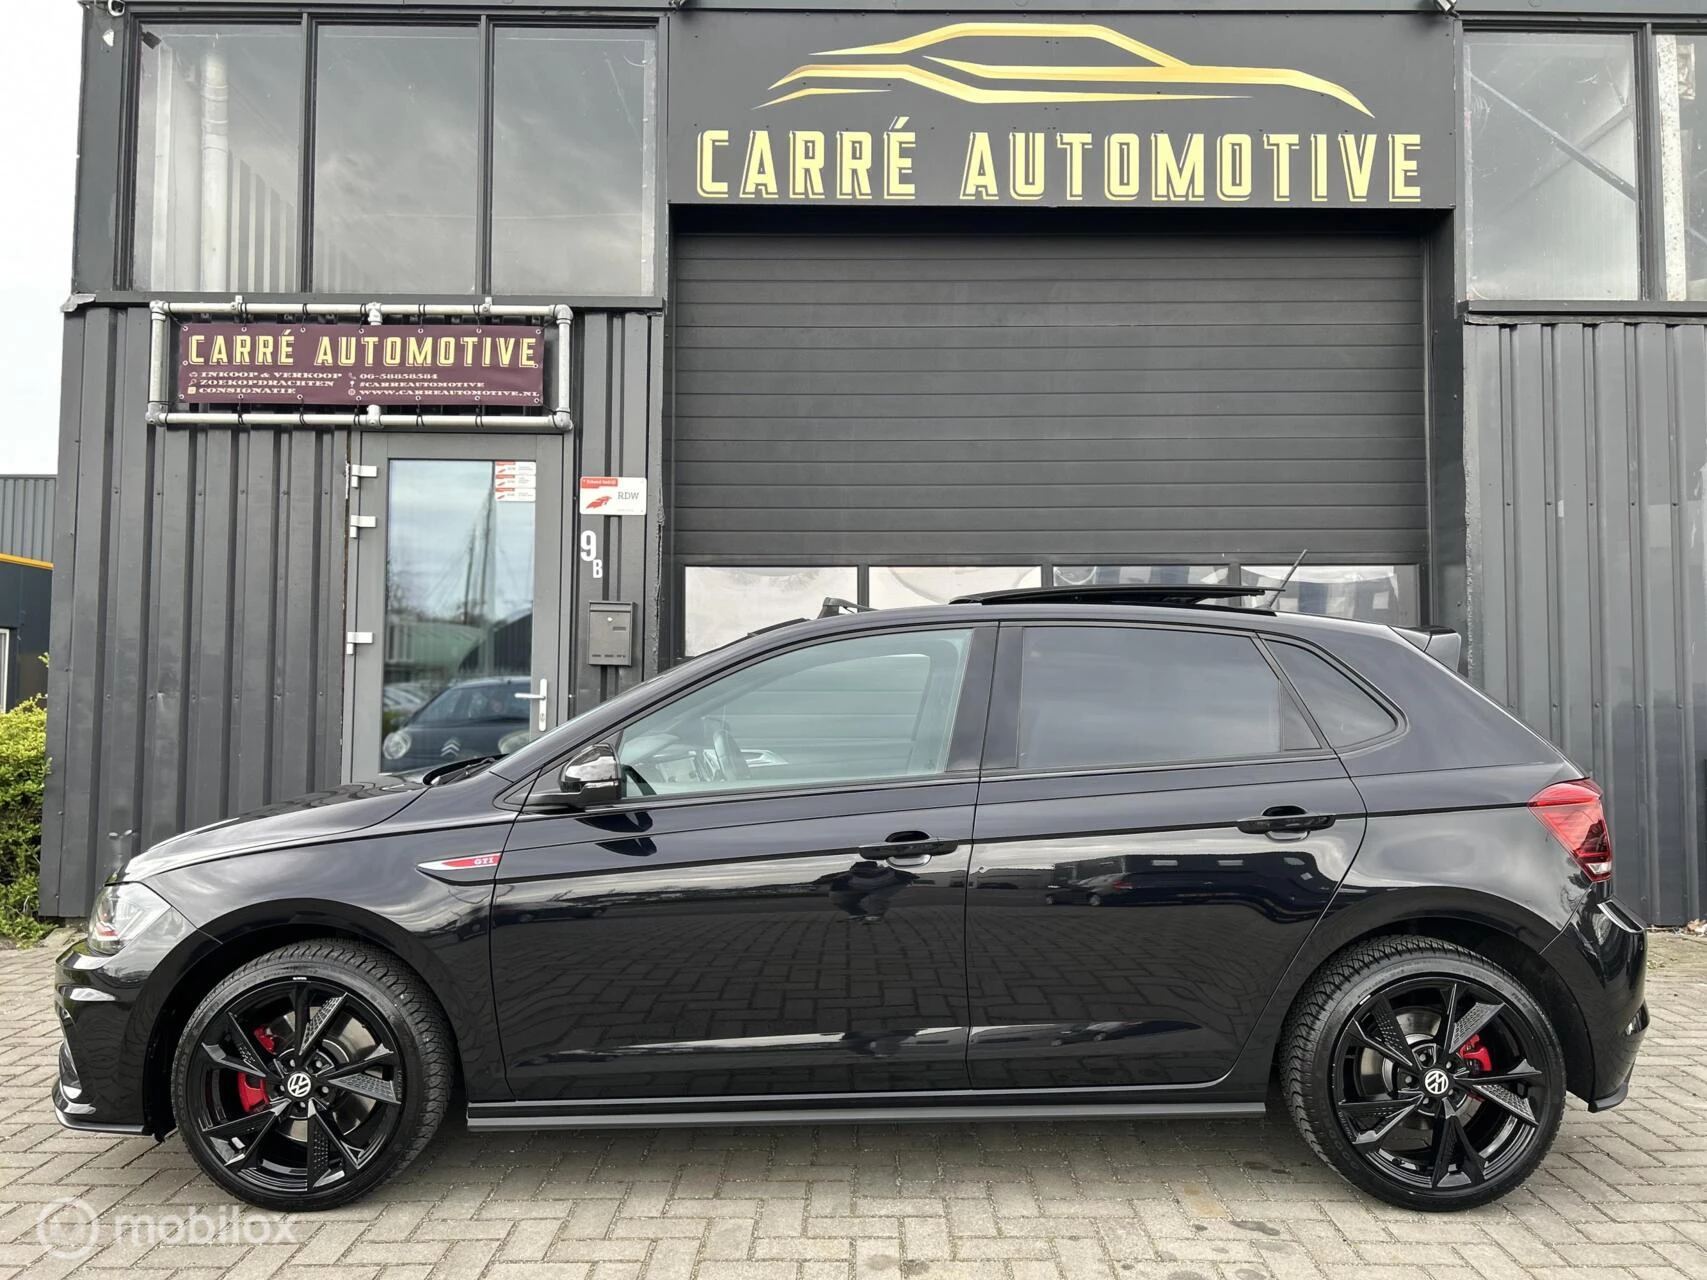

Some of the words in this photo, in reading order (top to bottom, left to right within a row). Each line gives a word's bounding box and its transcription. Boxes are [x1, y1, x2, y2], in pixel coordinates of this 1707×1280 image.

[696, 116, 917, 201] CARRÉ
[960, 131, 1422, 204] AUTOMOTIVE
[188, 329, 295, 366] CARRÉ
[314, 335, 537, 368] AUTOMOTIVE
[199, 379, 335, 387] ZOEKOPDRACHTEN
[359, 389, 540, 397] WWW.CARREAUTOMOTIVE.NL
[617, 491, 640, 500] RDW
[473, 857, 494, 866] GTI
